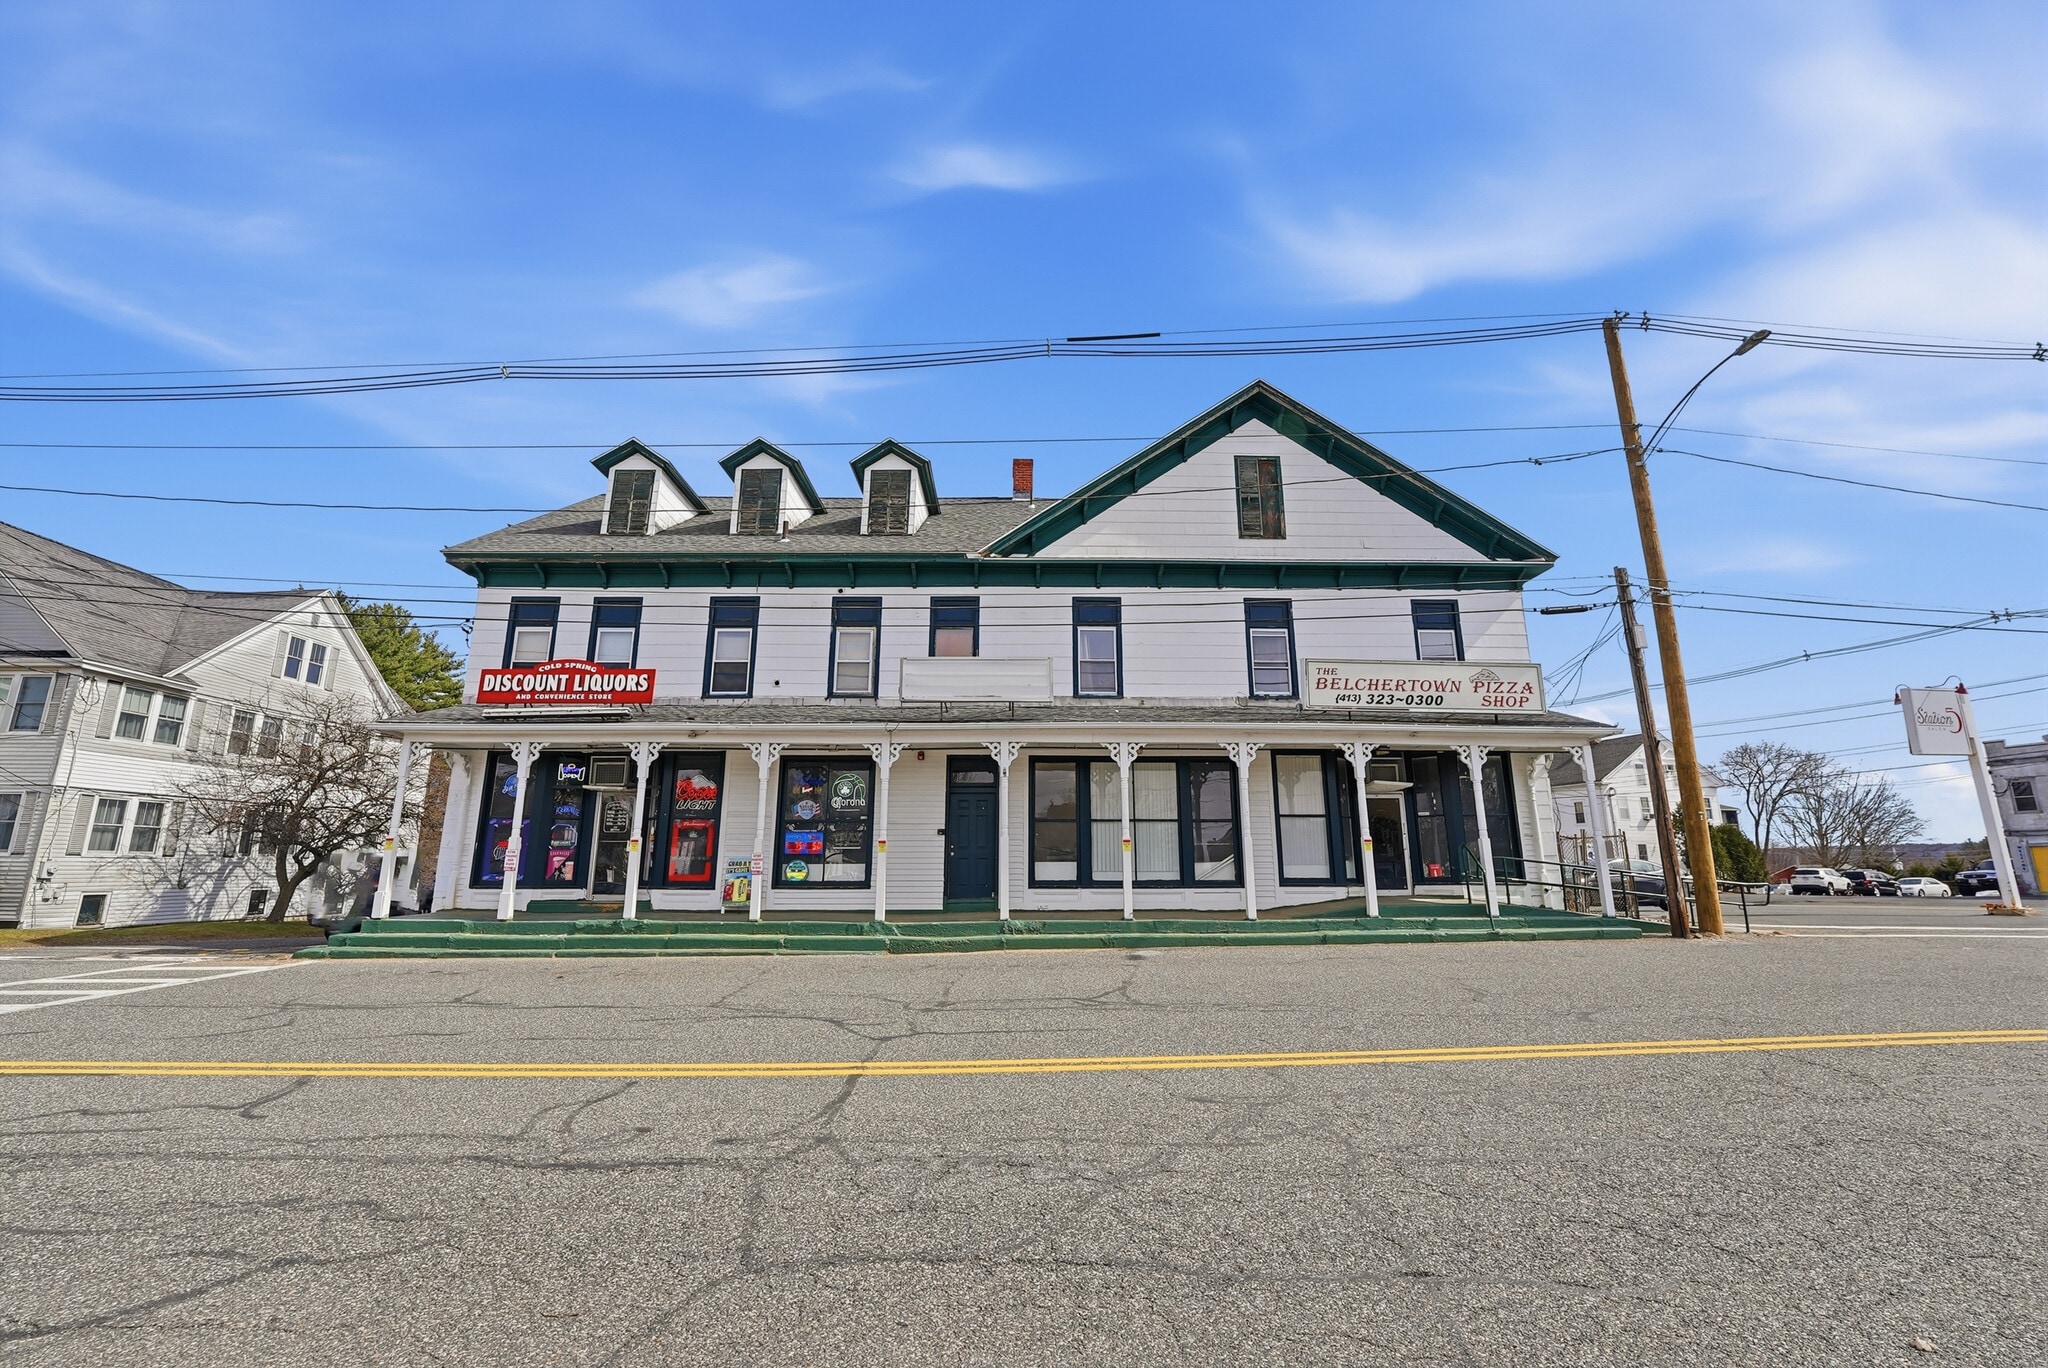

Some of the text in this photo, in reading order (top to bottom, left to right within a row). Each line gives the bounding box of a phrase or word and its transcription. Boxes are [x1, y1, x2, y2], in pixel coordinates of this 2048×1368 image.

[538, 662, 597, 673] COLD SPRING
[1316, 667, 1338, 675] THE
[482, 673, 649, 692] DISCOUNT LIQUORS
[1315, 677, 1534, 695] BELCHERTOWN PIZZA
[1335, 693, 1362, 704] (413)
[1481, 695, 1530, 708] SHOP
[1917, 706, 1954, 725] Station
[675, 799, 717, 811] LIGHT
[830, 796, 866, 809] Corona
